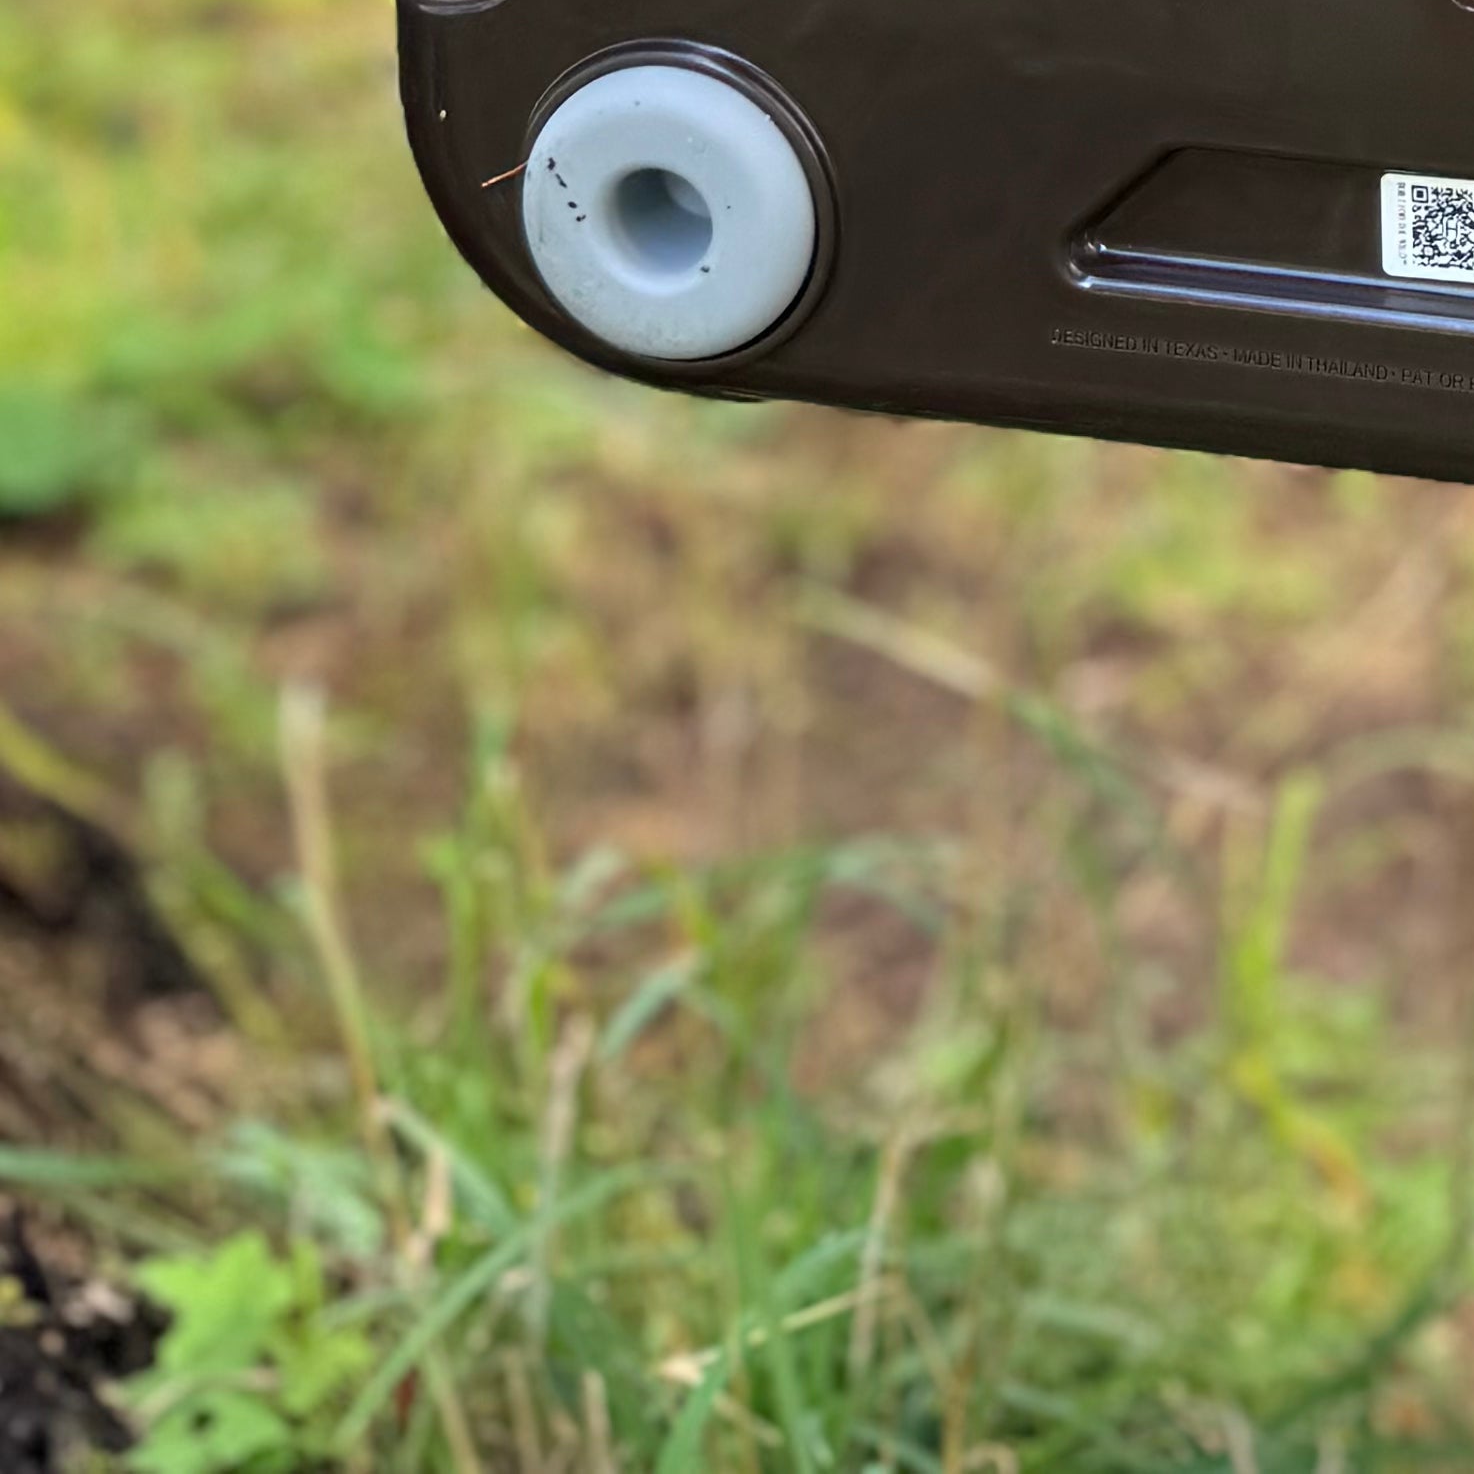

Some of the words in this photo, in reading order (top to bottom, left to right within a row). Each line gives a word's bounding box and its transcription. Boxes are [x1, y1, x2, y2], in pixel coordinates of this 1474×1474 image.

[1050, 327, 1138, 352] DESIGNED
[1141, 337, 1160, 354] IN
[1164, 340, 1219, 360] TEXAS
[1232, 348, 1282, 369] MADE
[1285, 352, 1303, 371] IN
[1306, 356, 1389, 381] THAILAND
[1400, 367, 1434, 386] PAT
[1438, 371, 1465, 390] OR
